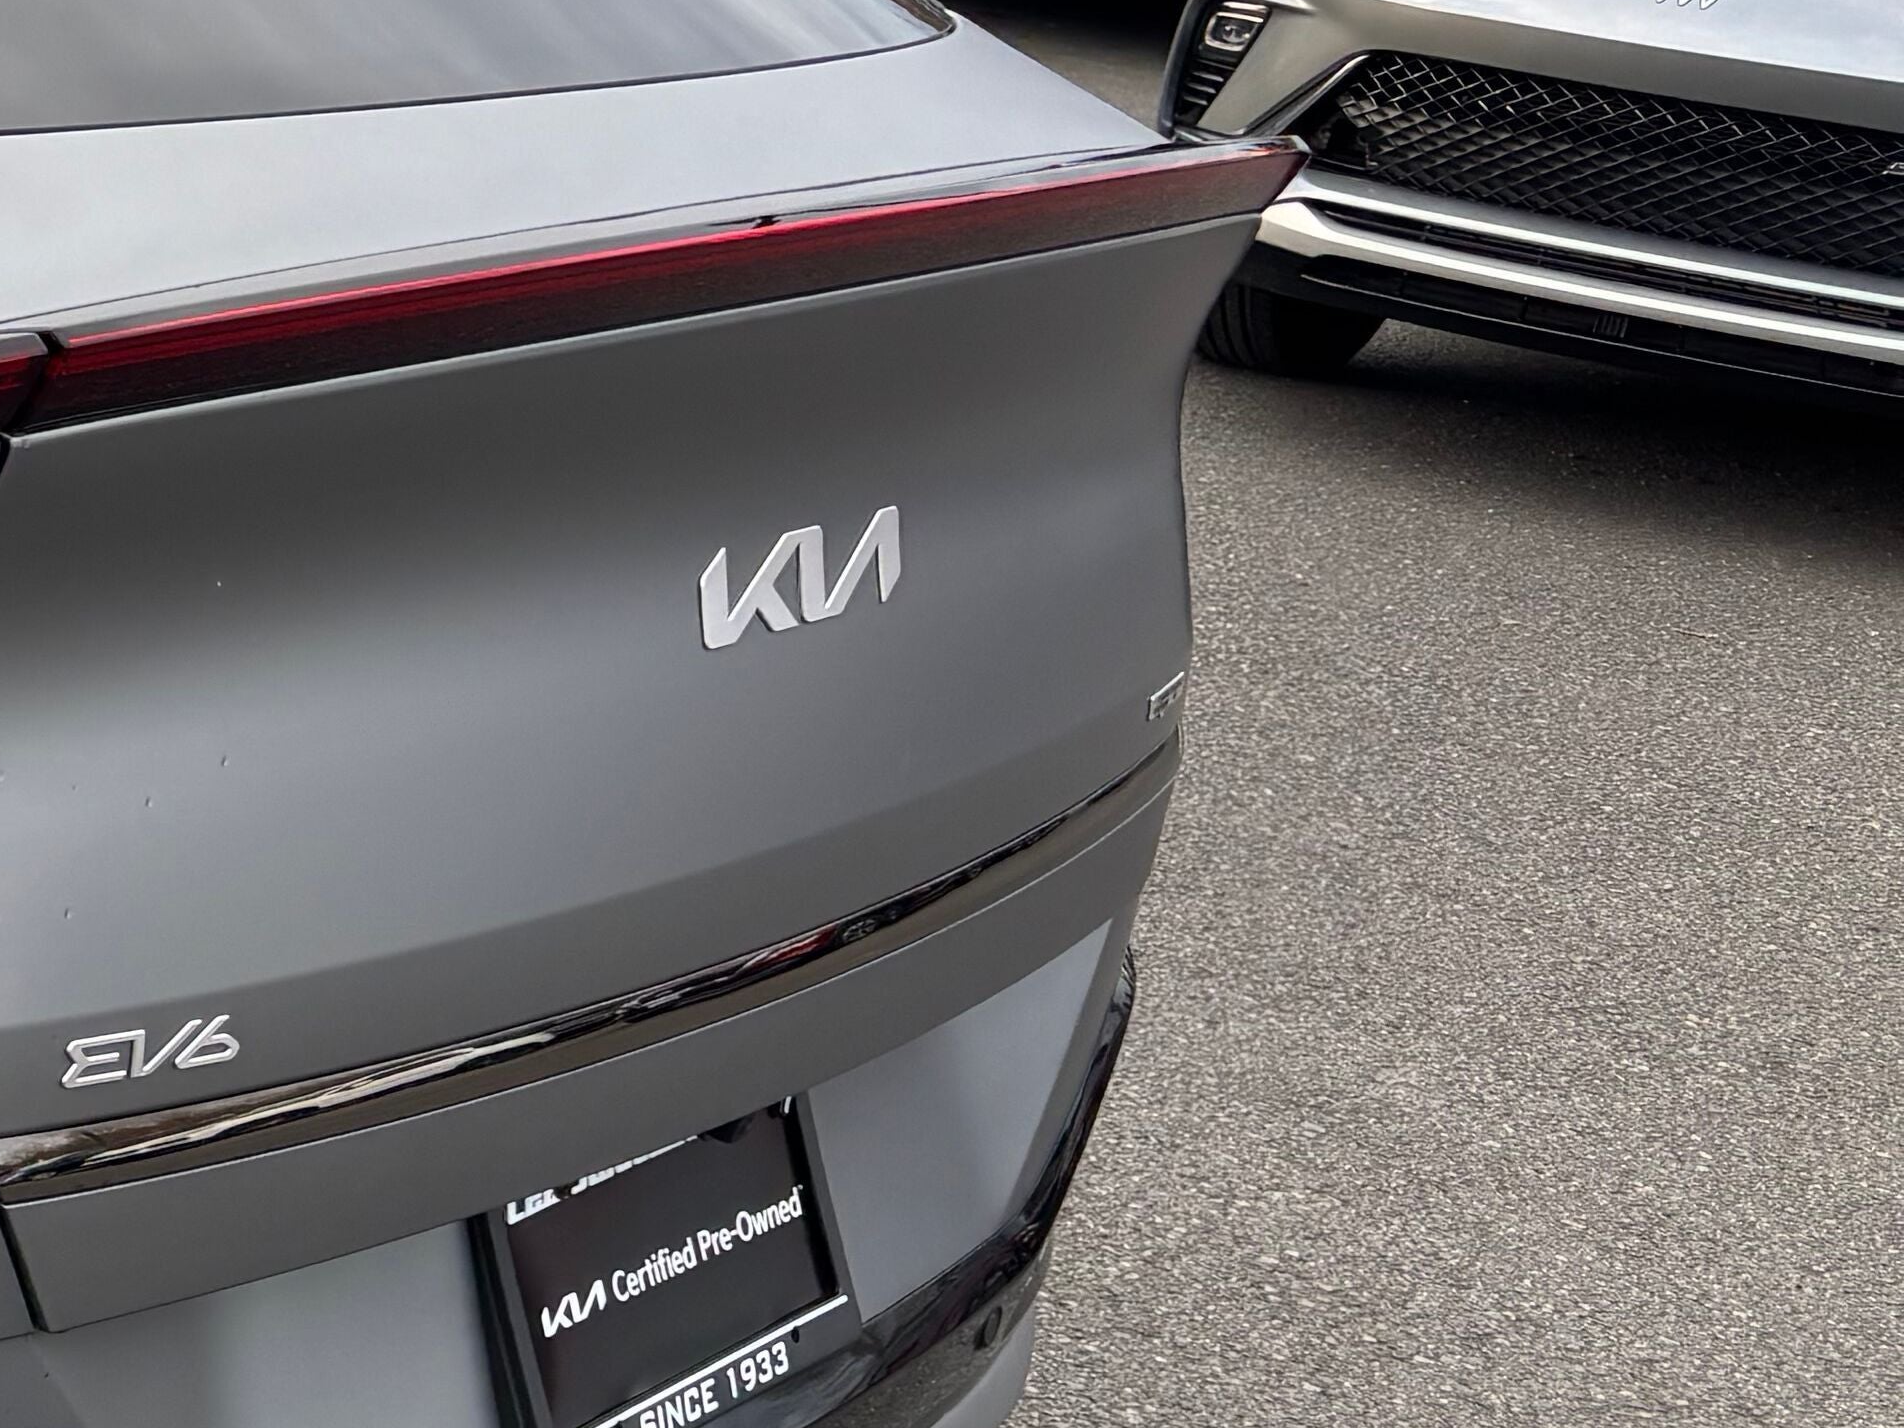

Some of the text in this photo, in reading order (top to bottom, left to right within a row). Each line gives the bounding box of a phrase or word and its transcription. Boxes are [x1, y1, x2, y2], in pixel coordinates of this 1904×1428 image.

[699, 505, 901, 650] KIA
[62, 1014, 240, 1088] EV6
[541, 1186, 803, 1337] KIA Certified Pre-Owned
[726, 1341, 789, 1399] 1933
